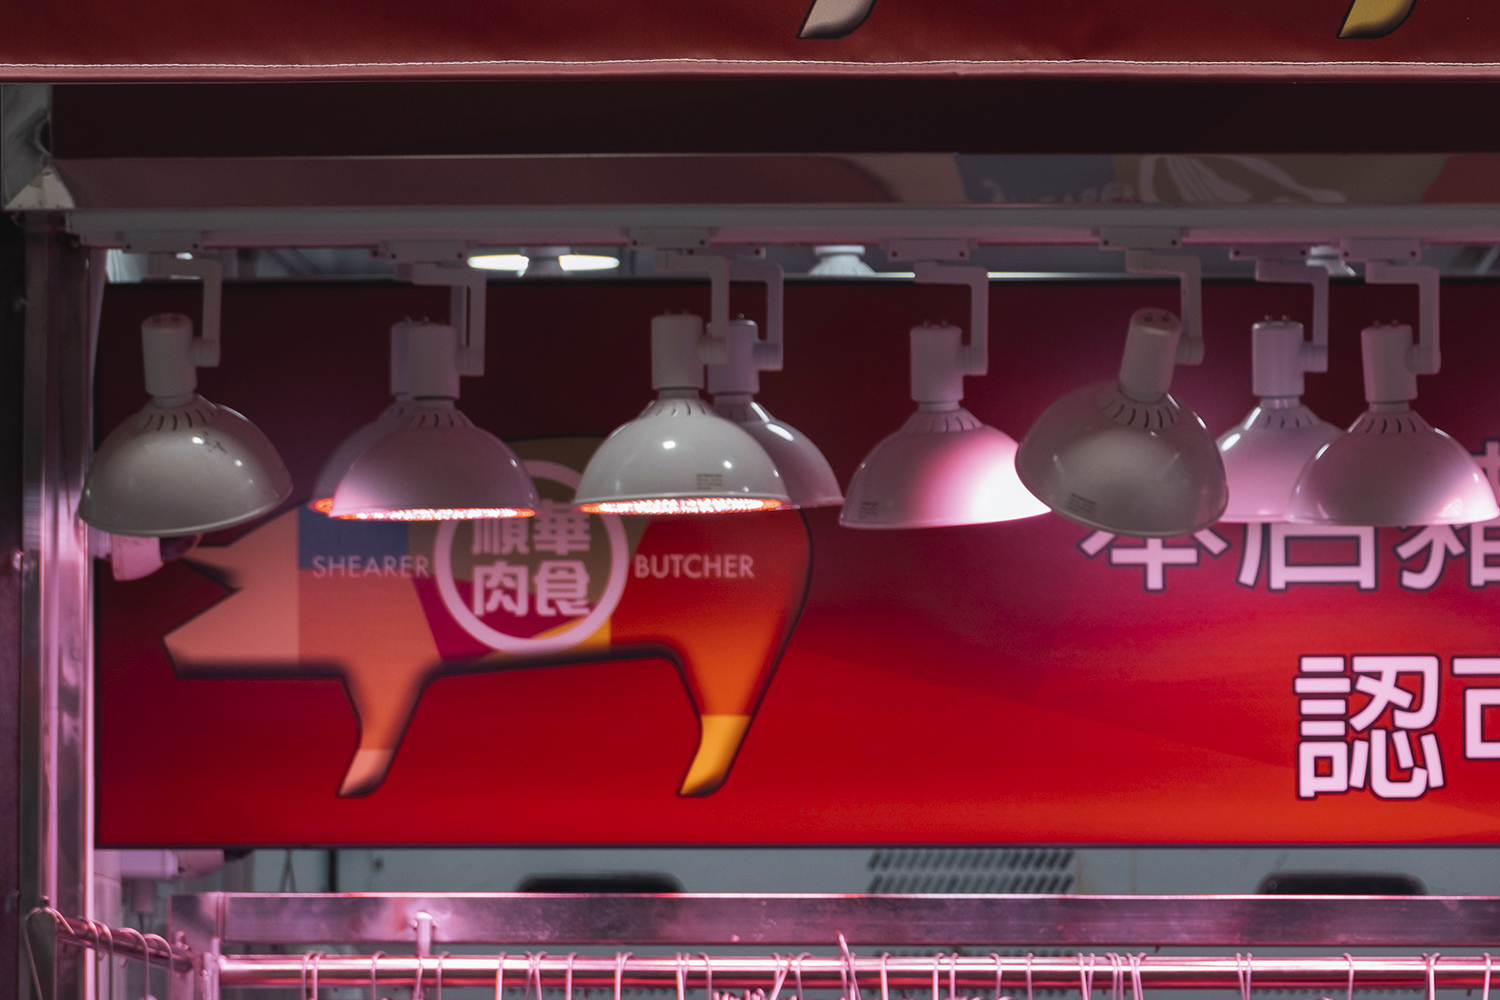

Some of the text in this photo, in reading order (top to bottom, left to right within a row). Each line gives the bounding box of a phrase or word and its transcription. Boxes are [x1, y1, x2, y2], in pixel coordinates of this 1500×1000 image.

[473, 499, 591, 555] 順華
[312, 553, 755, 579] SHEARER BUTCHER
[473, 560, 592, 617] 肉食
